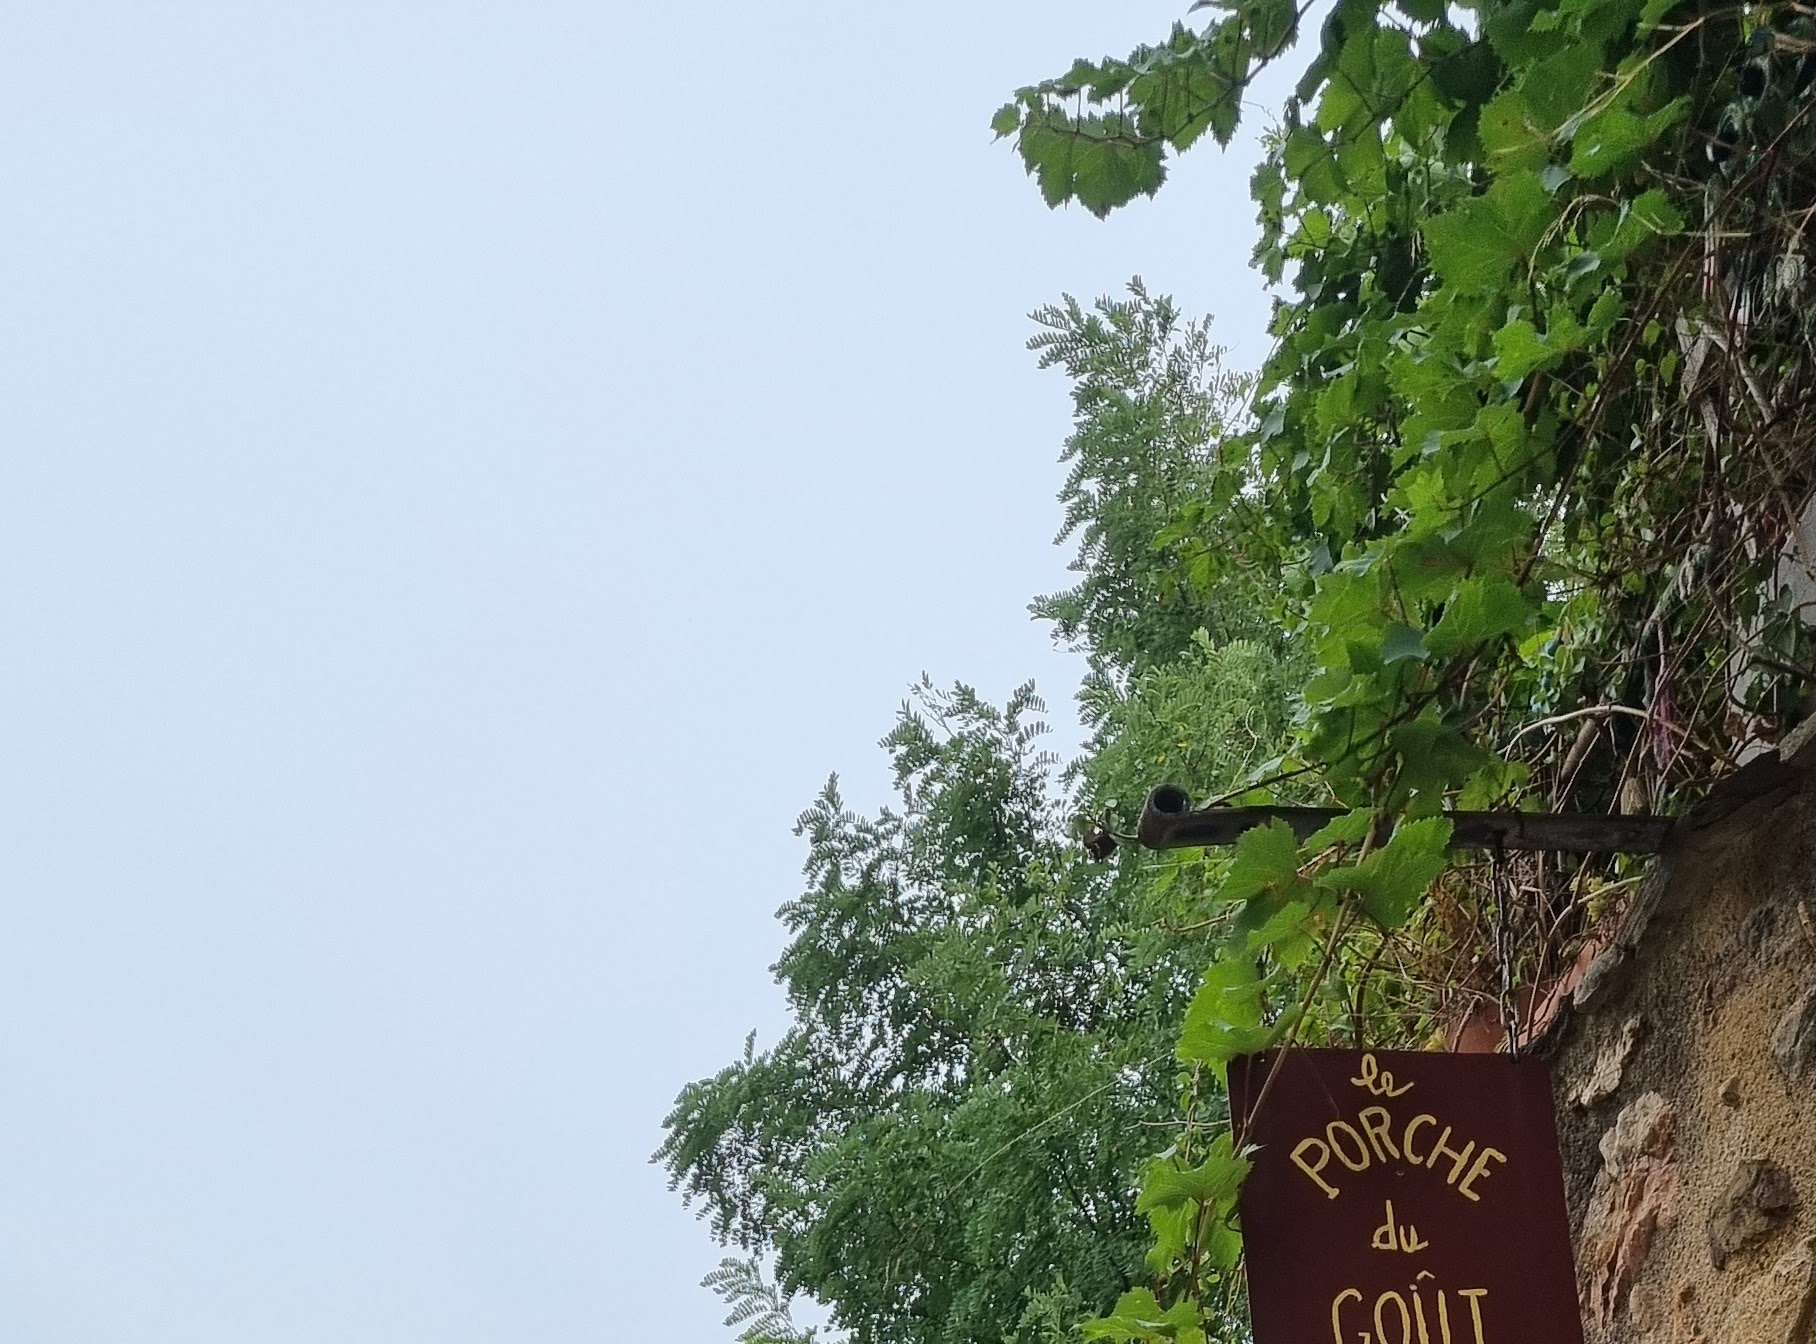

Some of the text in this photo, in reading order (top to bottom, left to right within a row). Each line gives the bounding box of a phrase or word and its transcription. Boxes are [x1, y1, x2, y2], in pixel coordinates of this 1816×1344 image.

[1351, 1053, 1414, 1097] le
[1290, 1105, 1508, 1201] PORCHE
[1372, 1199, 1429, 1254] du
